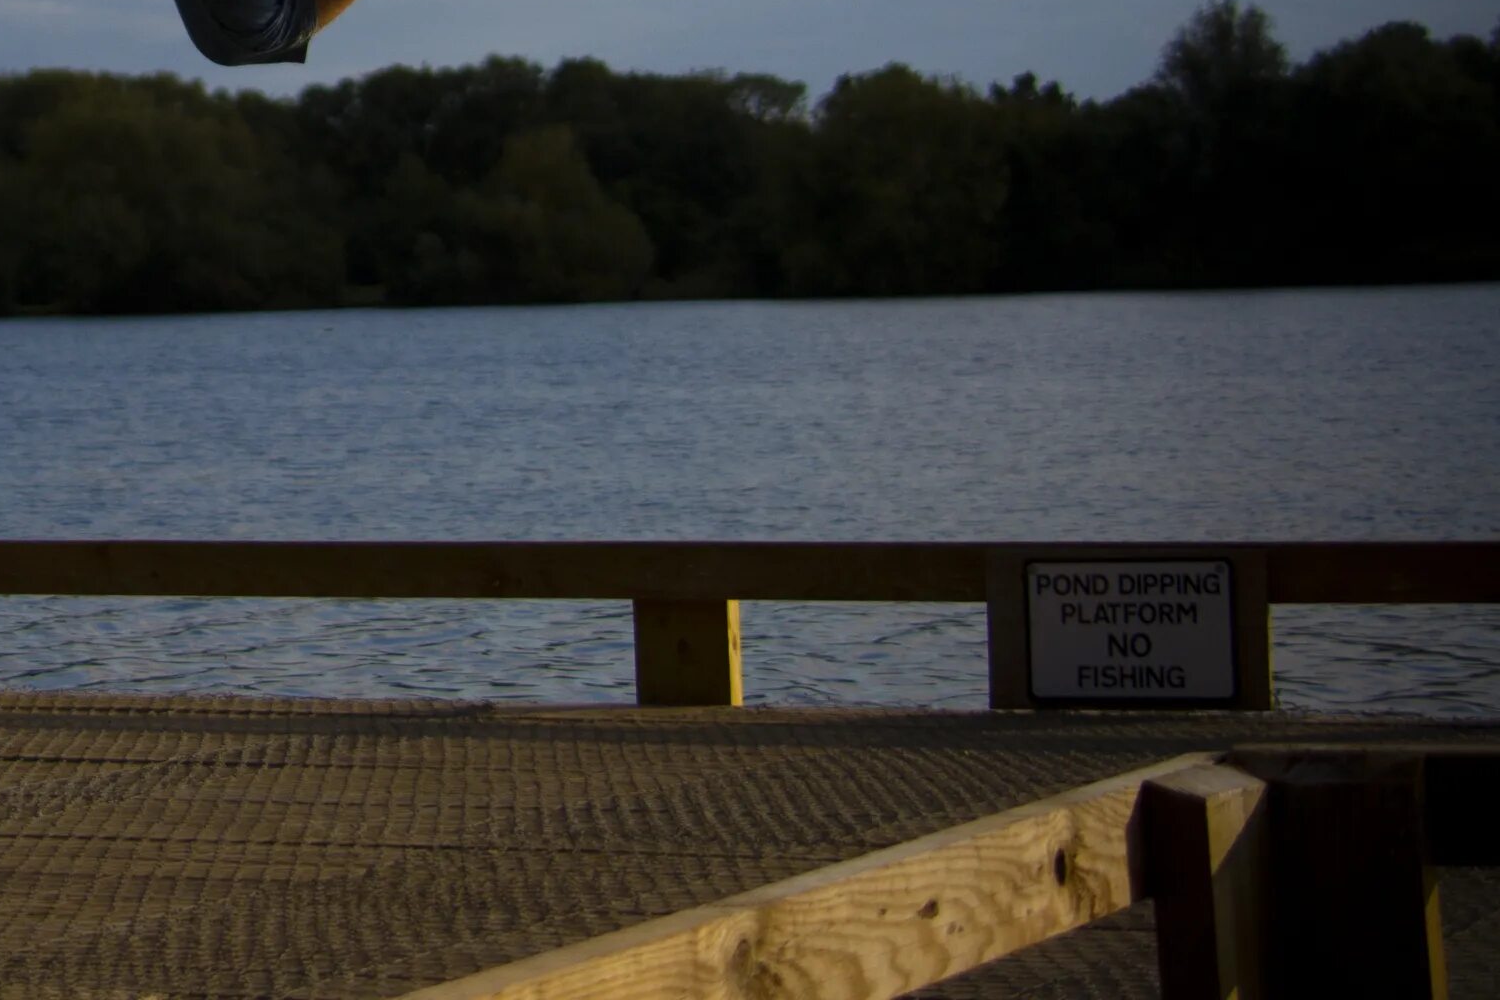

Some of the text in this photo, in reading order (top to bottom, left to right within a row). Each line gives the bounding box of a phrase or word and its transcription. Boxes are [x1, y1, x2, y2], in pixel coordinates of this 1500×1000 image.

[1035, 573, 1221, 596] POND DIPPING
[1061, 603, 1198, 625] PLATFORM
[1107, 632, 1152, 657] NO
[1077, 665, 1186, 689] FISHING
